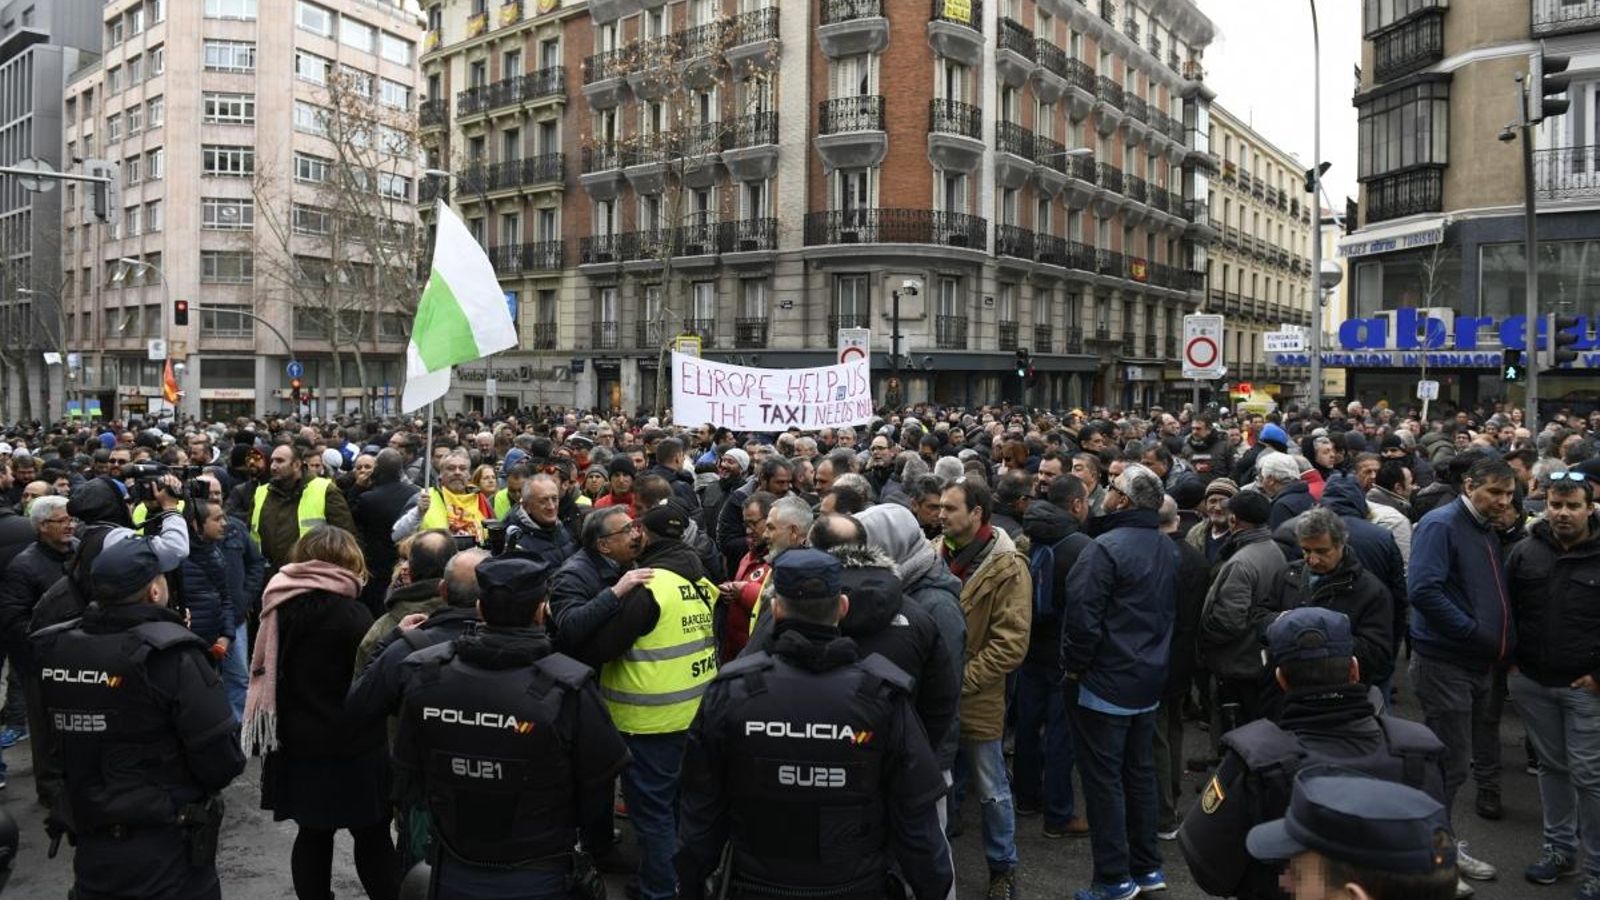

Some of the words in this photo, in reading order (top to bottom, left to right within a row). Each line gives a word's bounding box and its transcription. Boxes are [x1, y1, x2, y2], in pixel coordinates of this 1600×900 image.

[1276, 352, 1393, 367] ORGNIZACION
[1402, 353, 1529, 368] INERNACIOA
[682, 361, 773, 401] EUROPE
[787, 370, 838, 403] HELP
[847, 362, 866, 397] US
[706, 401, 747, 428] THE
[759, 404, 806, 425] TAXI
[815, 401, 853, 426] NEEDS
[42, 668, 110, 686] POLICIA
[423, 706, 519, 730] POLICIA
[745, 721, 856, 741] POLICIA
[451, 757, 503, 780] 6U21
[778, 765, 847, 787] 6U23
